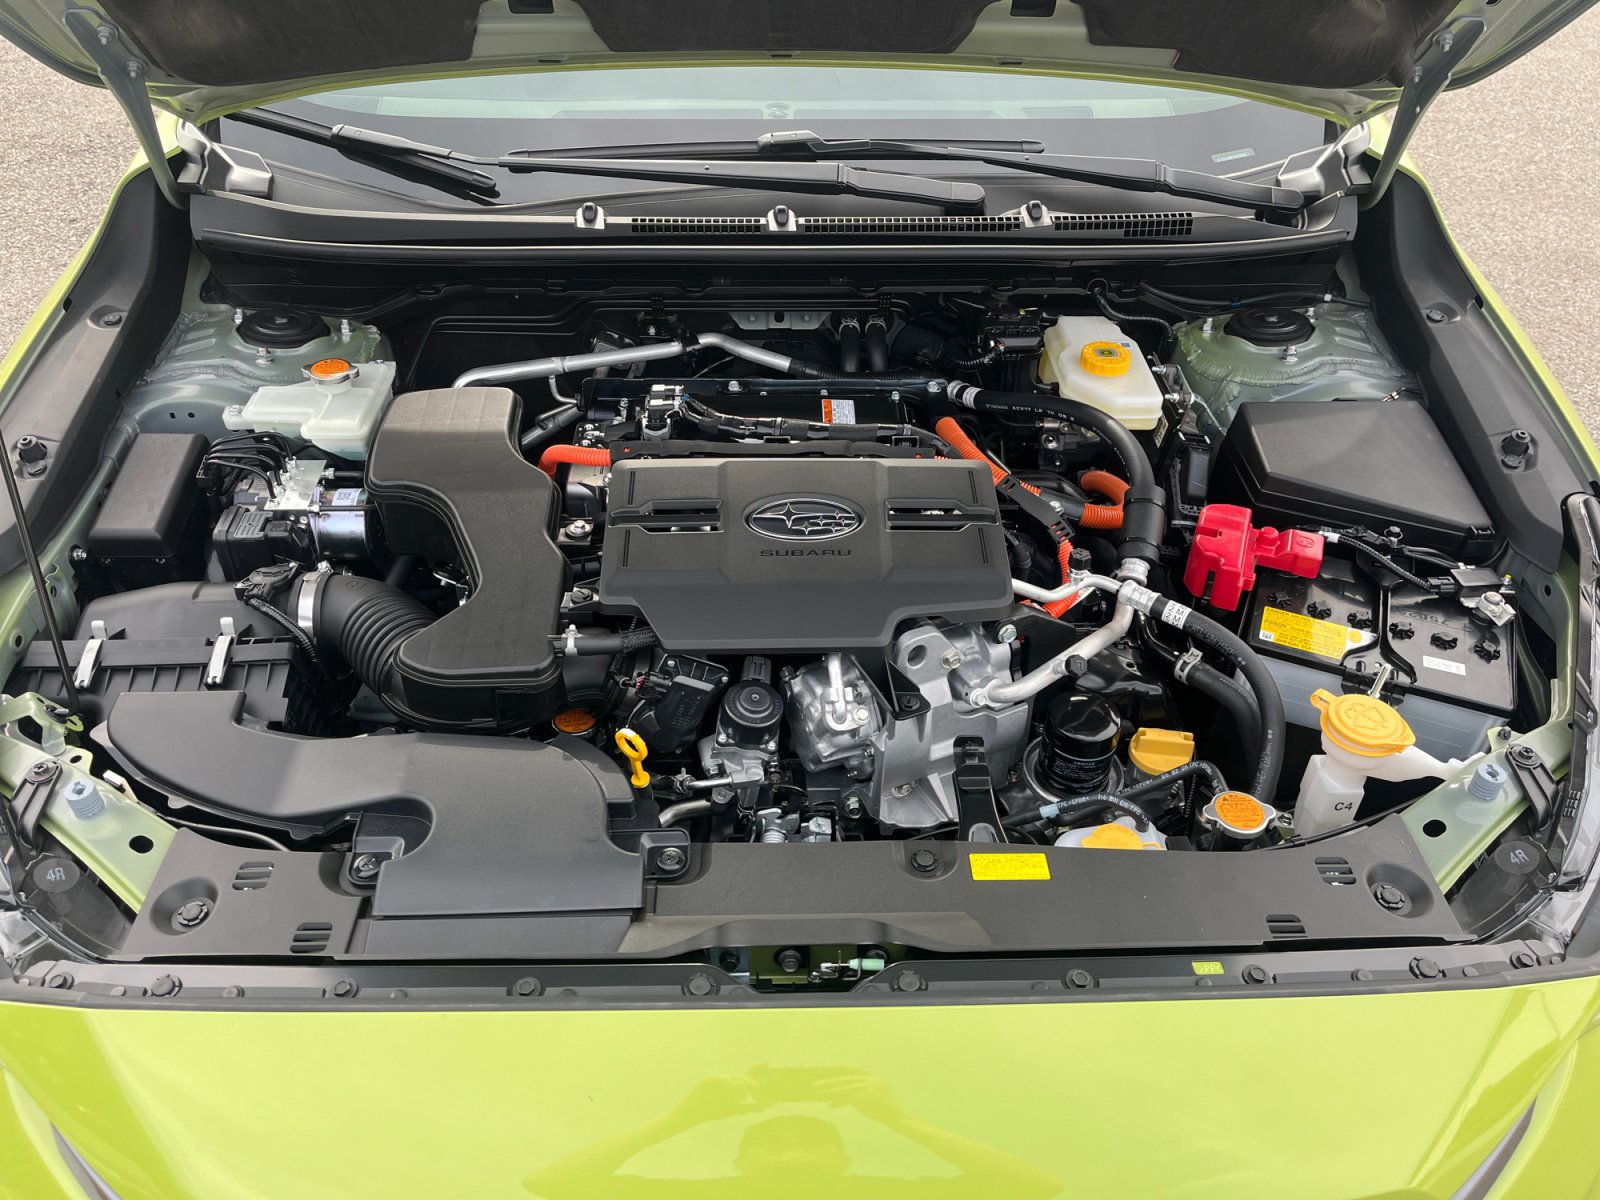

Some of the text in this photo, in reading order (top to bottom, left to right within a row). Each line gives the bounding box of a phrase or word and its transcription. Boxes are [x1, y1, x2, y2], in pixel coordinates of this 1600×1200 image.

[759, 549, 851, 557] SUBARU
[1334, 801, 1353, 811] C4
[1510, 849, 1530, 865] 4R
[46, 867, 66, 882] 4R
